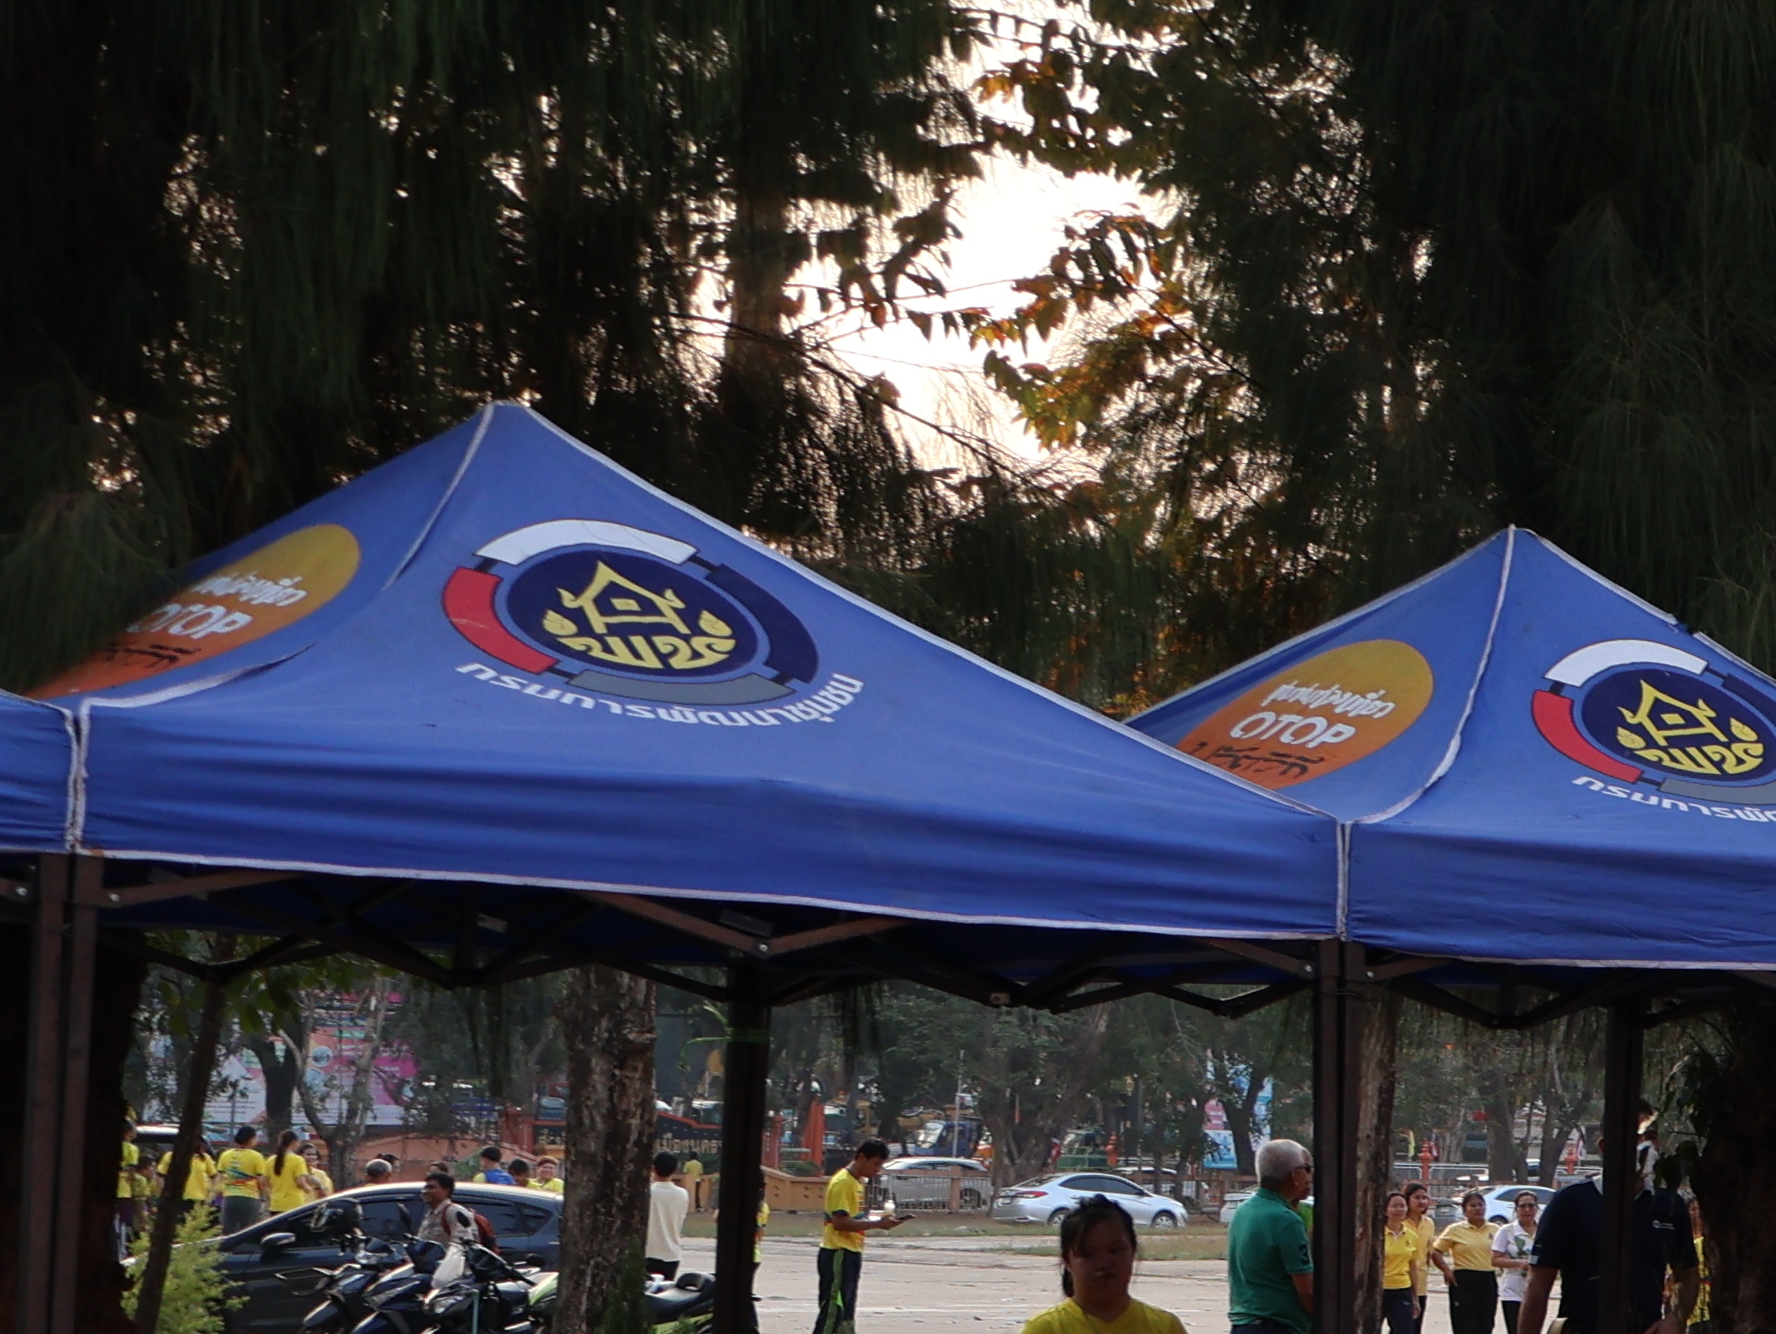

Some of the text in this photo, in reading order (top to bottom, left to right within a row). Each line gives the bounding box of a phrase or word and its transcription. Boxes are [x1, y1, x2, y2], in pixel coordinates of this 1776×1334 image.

[455, 661, 866, 727] กรมการพัฒนาชุมชน
[1229, 711, 1357, 749] OTOP
